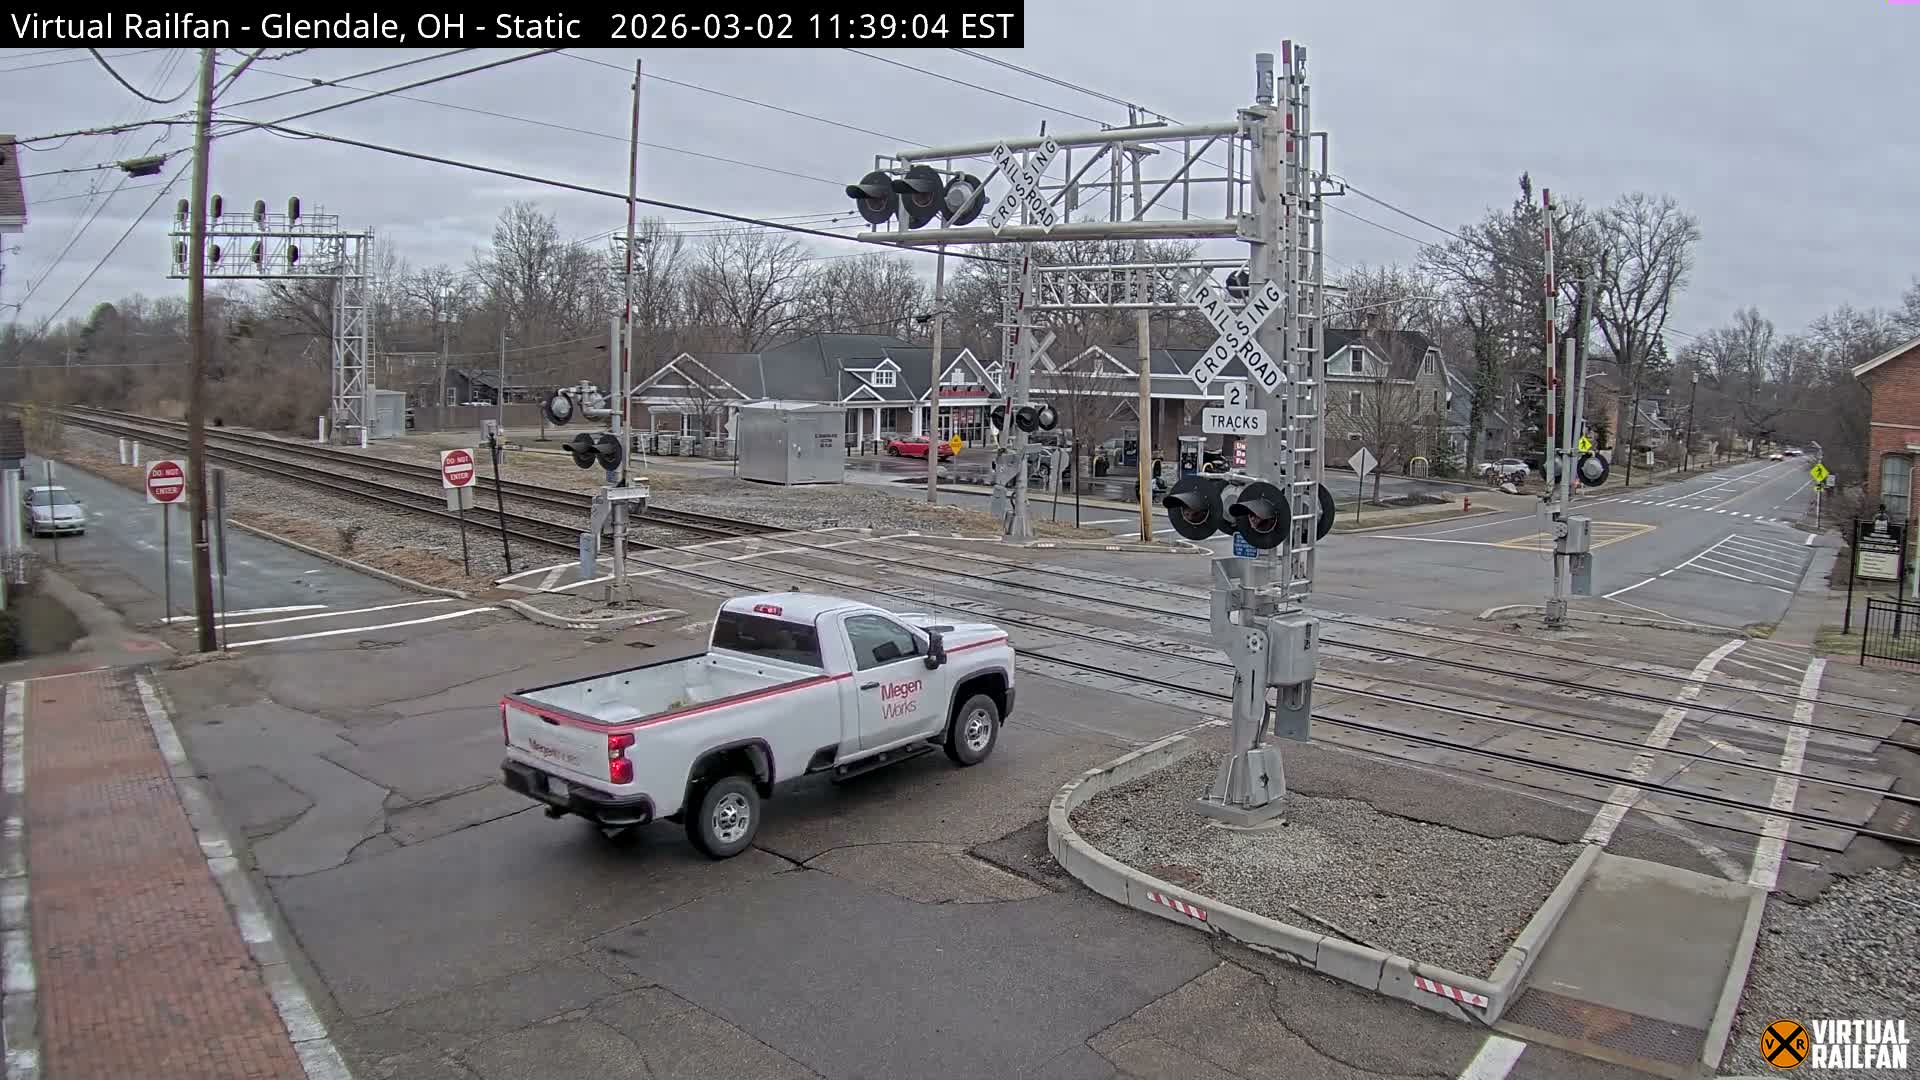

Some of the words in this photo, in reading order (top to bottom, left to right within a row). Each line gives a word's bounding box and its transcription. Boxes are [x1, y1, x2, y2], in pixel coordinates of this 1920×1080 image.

[991, 140, 1056, 229] CROSSING
[1194, 286, 1280, 384] CROSSING
[1230, 388, 1240, 405] 2
[1211, 415, 1259, 430] TRACKS
[456, 455, 469, 463] NOT
[152, 469, 162, 477] DO
[450, 472, 470, 481] ENTER
[881, 680, 922, 701] Megen
[882, 700, 917, 719] Works
